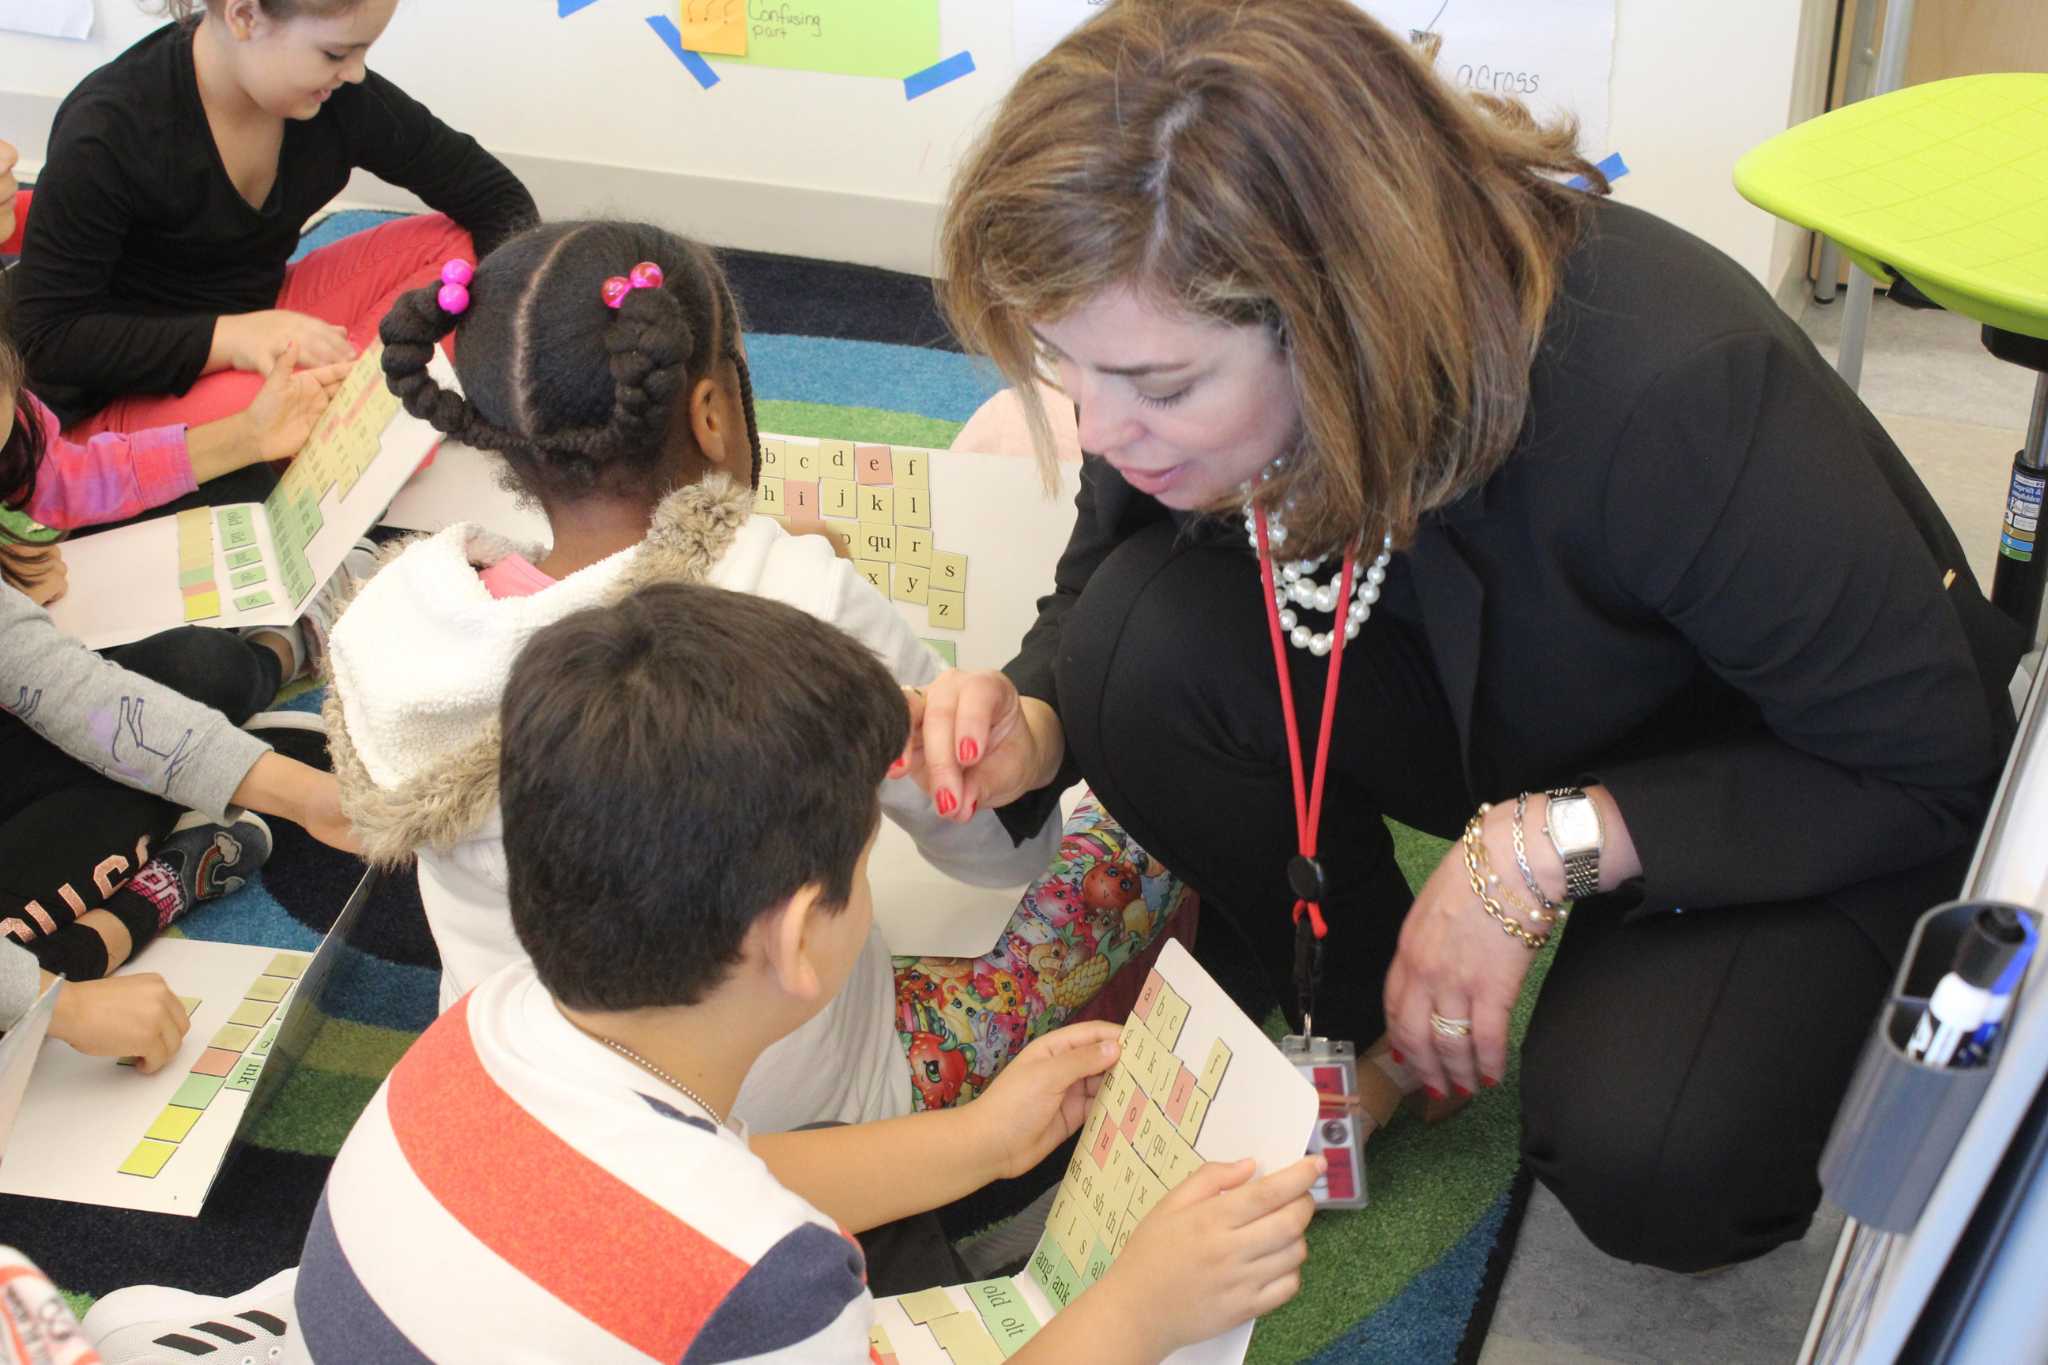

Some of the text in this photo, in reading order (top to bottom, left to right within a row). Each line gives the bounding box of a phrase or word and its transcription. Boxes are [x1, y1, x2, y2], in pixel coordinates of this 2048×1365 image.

[752, 25, 787, 40] part
[1456, 64, 1541, 94] across
[765, 448, 917, 476] b c d e f
[764, 485, 916, 514] h i j k l
[868, 534, 891, 552] qu
[912, 540, 921, 553] r
[867, 564, 955, 592] x y s
[938, 603, 949, 616] z
[1156, 995, 1166, 1017] b
[1169, 1015, 1178, 1031] c
[1210, 1054, 1221, 1075] f
[237, 1064, 260, 1085] ink
[1135, 1038, 1145, 1060] h
[1147, 1052, 1157, 1074] k
[1160, 1068, 1171, 1092] j
[1104, 1071, 1179, 1169] m n o p qu r
[1101, 1133, 1110, 1150] u
[1113, 1149, 1121, 1166] v
[1125, 1166, 1135, 1184] w
[1137, 1185, 1148, 1205] x
[1069, 1157, 1082, 1184] wh
[1081, 1175, 1093, 1198] ch
[1093, 1192, 1105, 1217] sh
[1105, 1211, 1117, 1234] th
[1055, 1199, 1064, 1219] f
[1079, 1239, 1088, 1255] s
[1035, 1251, 1070, 1307] ang ank
[983, 1285, 1012, 1308] old
[1001, 1317, 1025, 1338] olt
